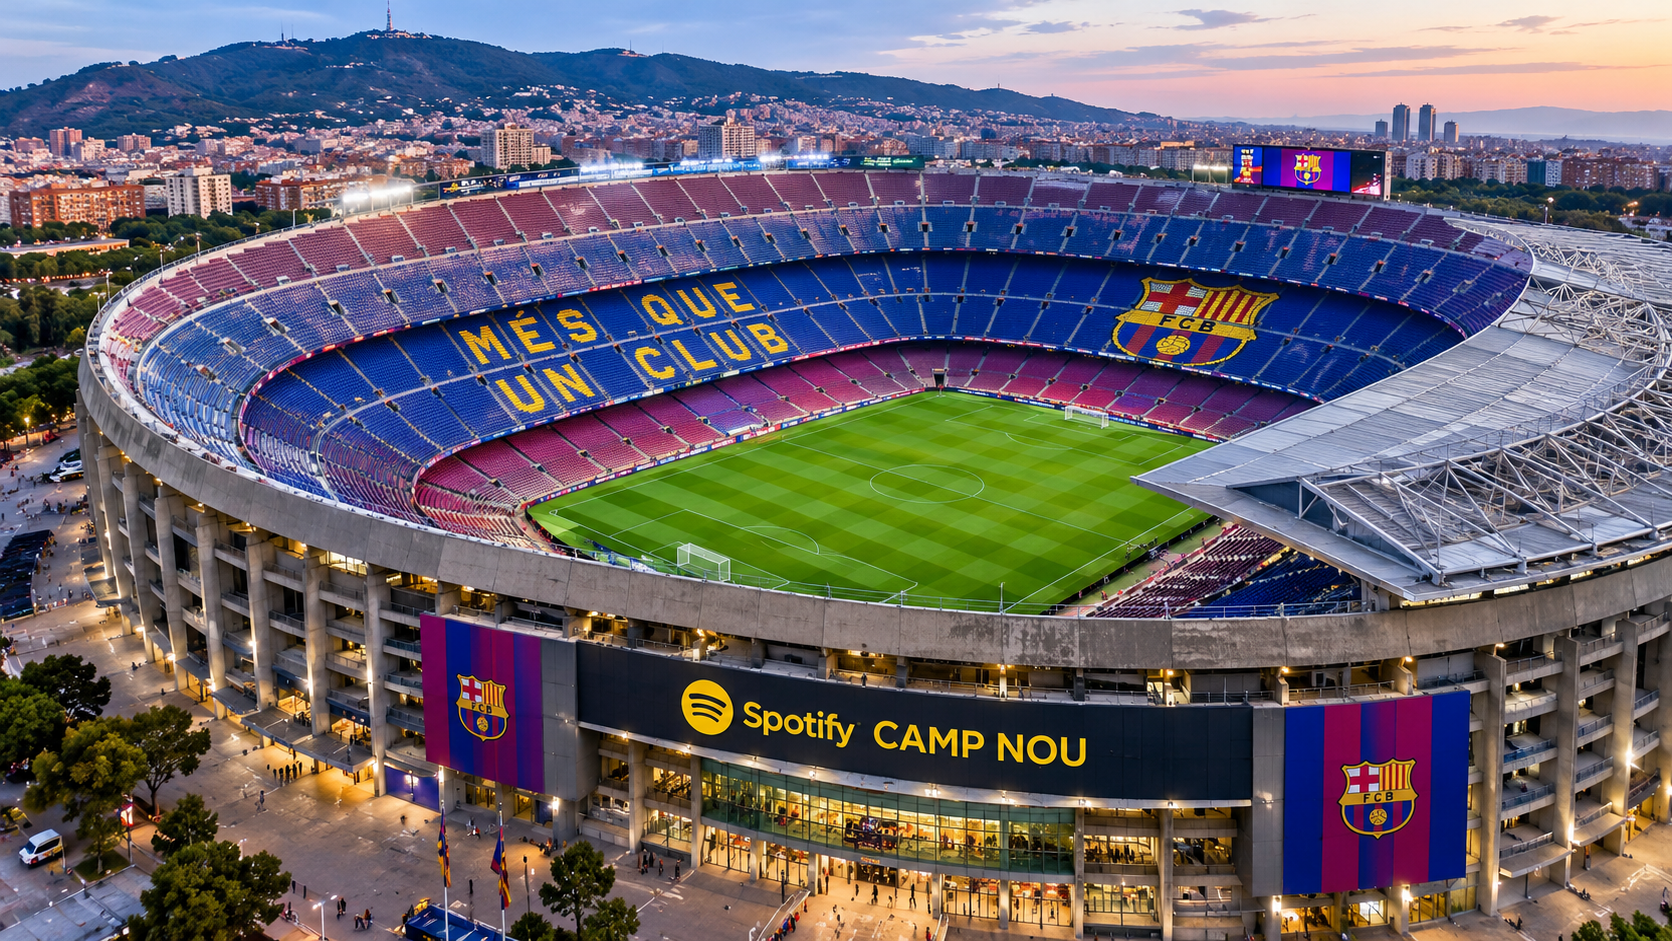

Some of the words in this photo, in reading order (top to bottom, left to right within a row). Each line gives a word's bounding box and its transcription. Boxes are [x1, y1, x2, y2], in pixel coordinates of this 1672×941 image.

[459, 309, 597, 364] MÉS
[642, 282, 754, 325] QUE
[1158, 315, 1216, 332] FCB
[496, 364, 594, 412] UN
[636, 324, 787, 379] CLUB
[471, 702, 492, 713] FCB
[743, 701, 855, 748] Spotify
[873, 720, 985, 759] CAMP
[997, 732, 1087, 767] NOU
[1363, 791, 1394, 803] FCB
